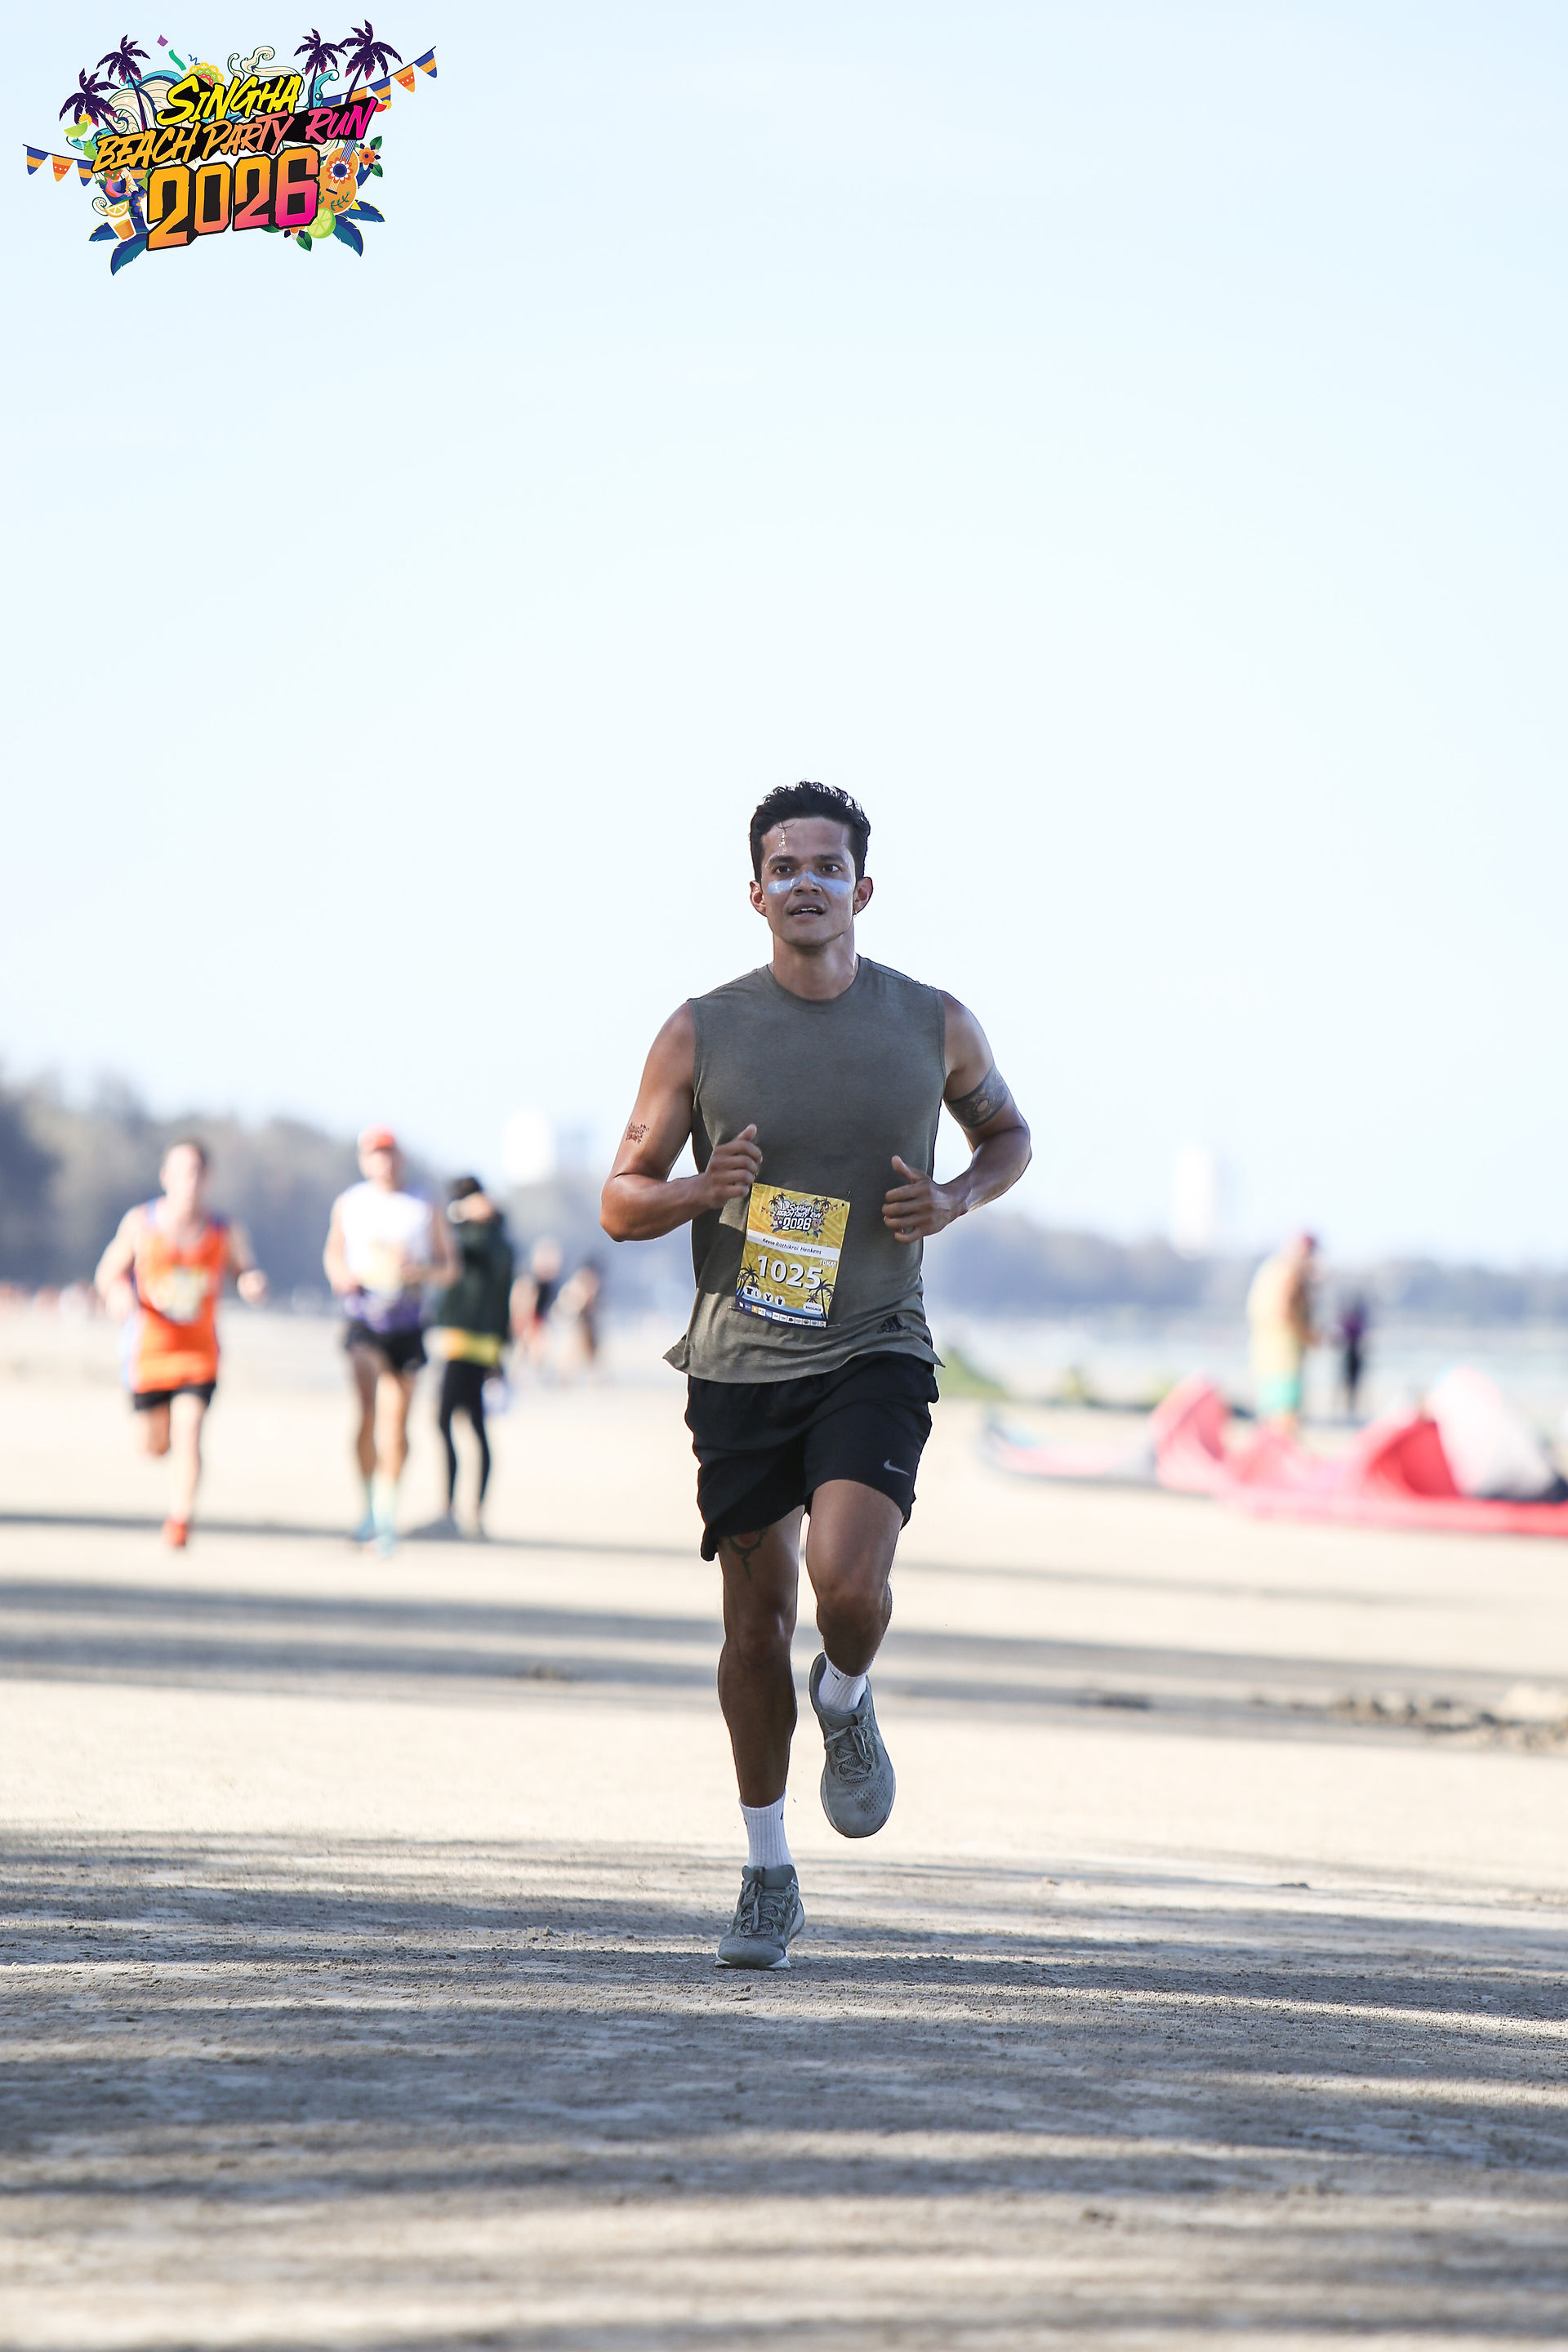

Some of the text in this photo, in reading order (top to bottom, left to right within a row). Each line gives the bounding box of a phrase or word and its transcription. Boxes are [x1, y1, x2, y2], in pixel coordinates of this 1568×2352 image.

[782, 1217, 812, 1231] 2026
[800, 1246, 822, 1254] Henkens
[819, 1259, 836, 1267] 10KM
[758, 1255, 822, 1290] 1025
